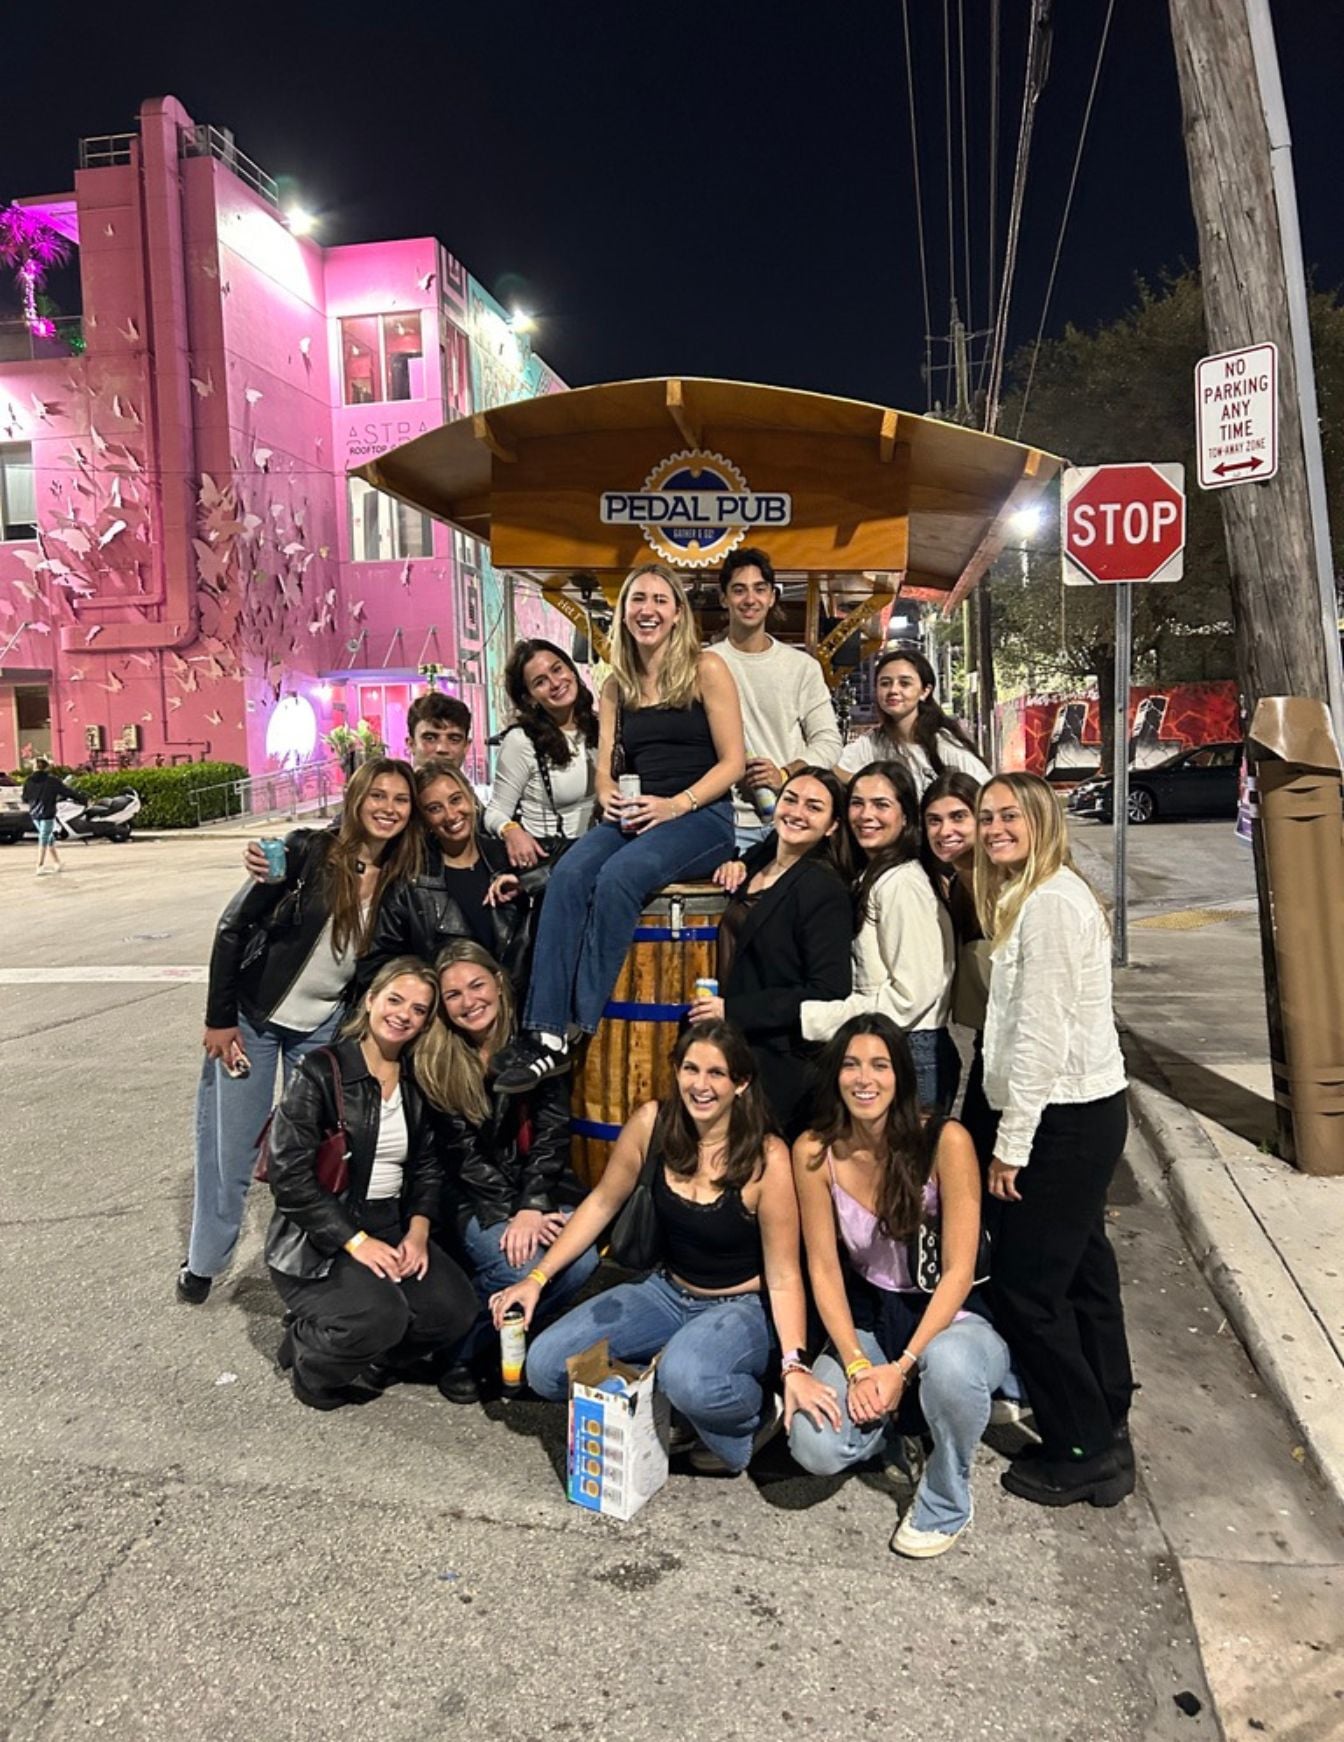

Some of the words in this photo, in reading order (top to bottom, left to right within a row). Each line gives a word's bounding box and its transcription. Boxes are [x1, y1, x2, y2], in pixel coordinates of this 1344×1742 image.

[1225, 358, 1246, 378] NO
[1204, 375, 1268, 404] PARKING
[1221, 400, 1250, 420] ANY
[1220, 420, 1253, 440] TIME
[349, 445, 387, 455] ROOFTOP
[1245, 438, 1266, 453] ZONE
[604, 495, 710, 521] PEDAL
[716, 496, 787, 522] PUB
[1072, 501, 1178, 547] STOP
